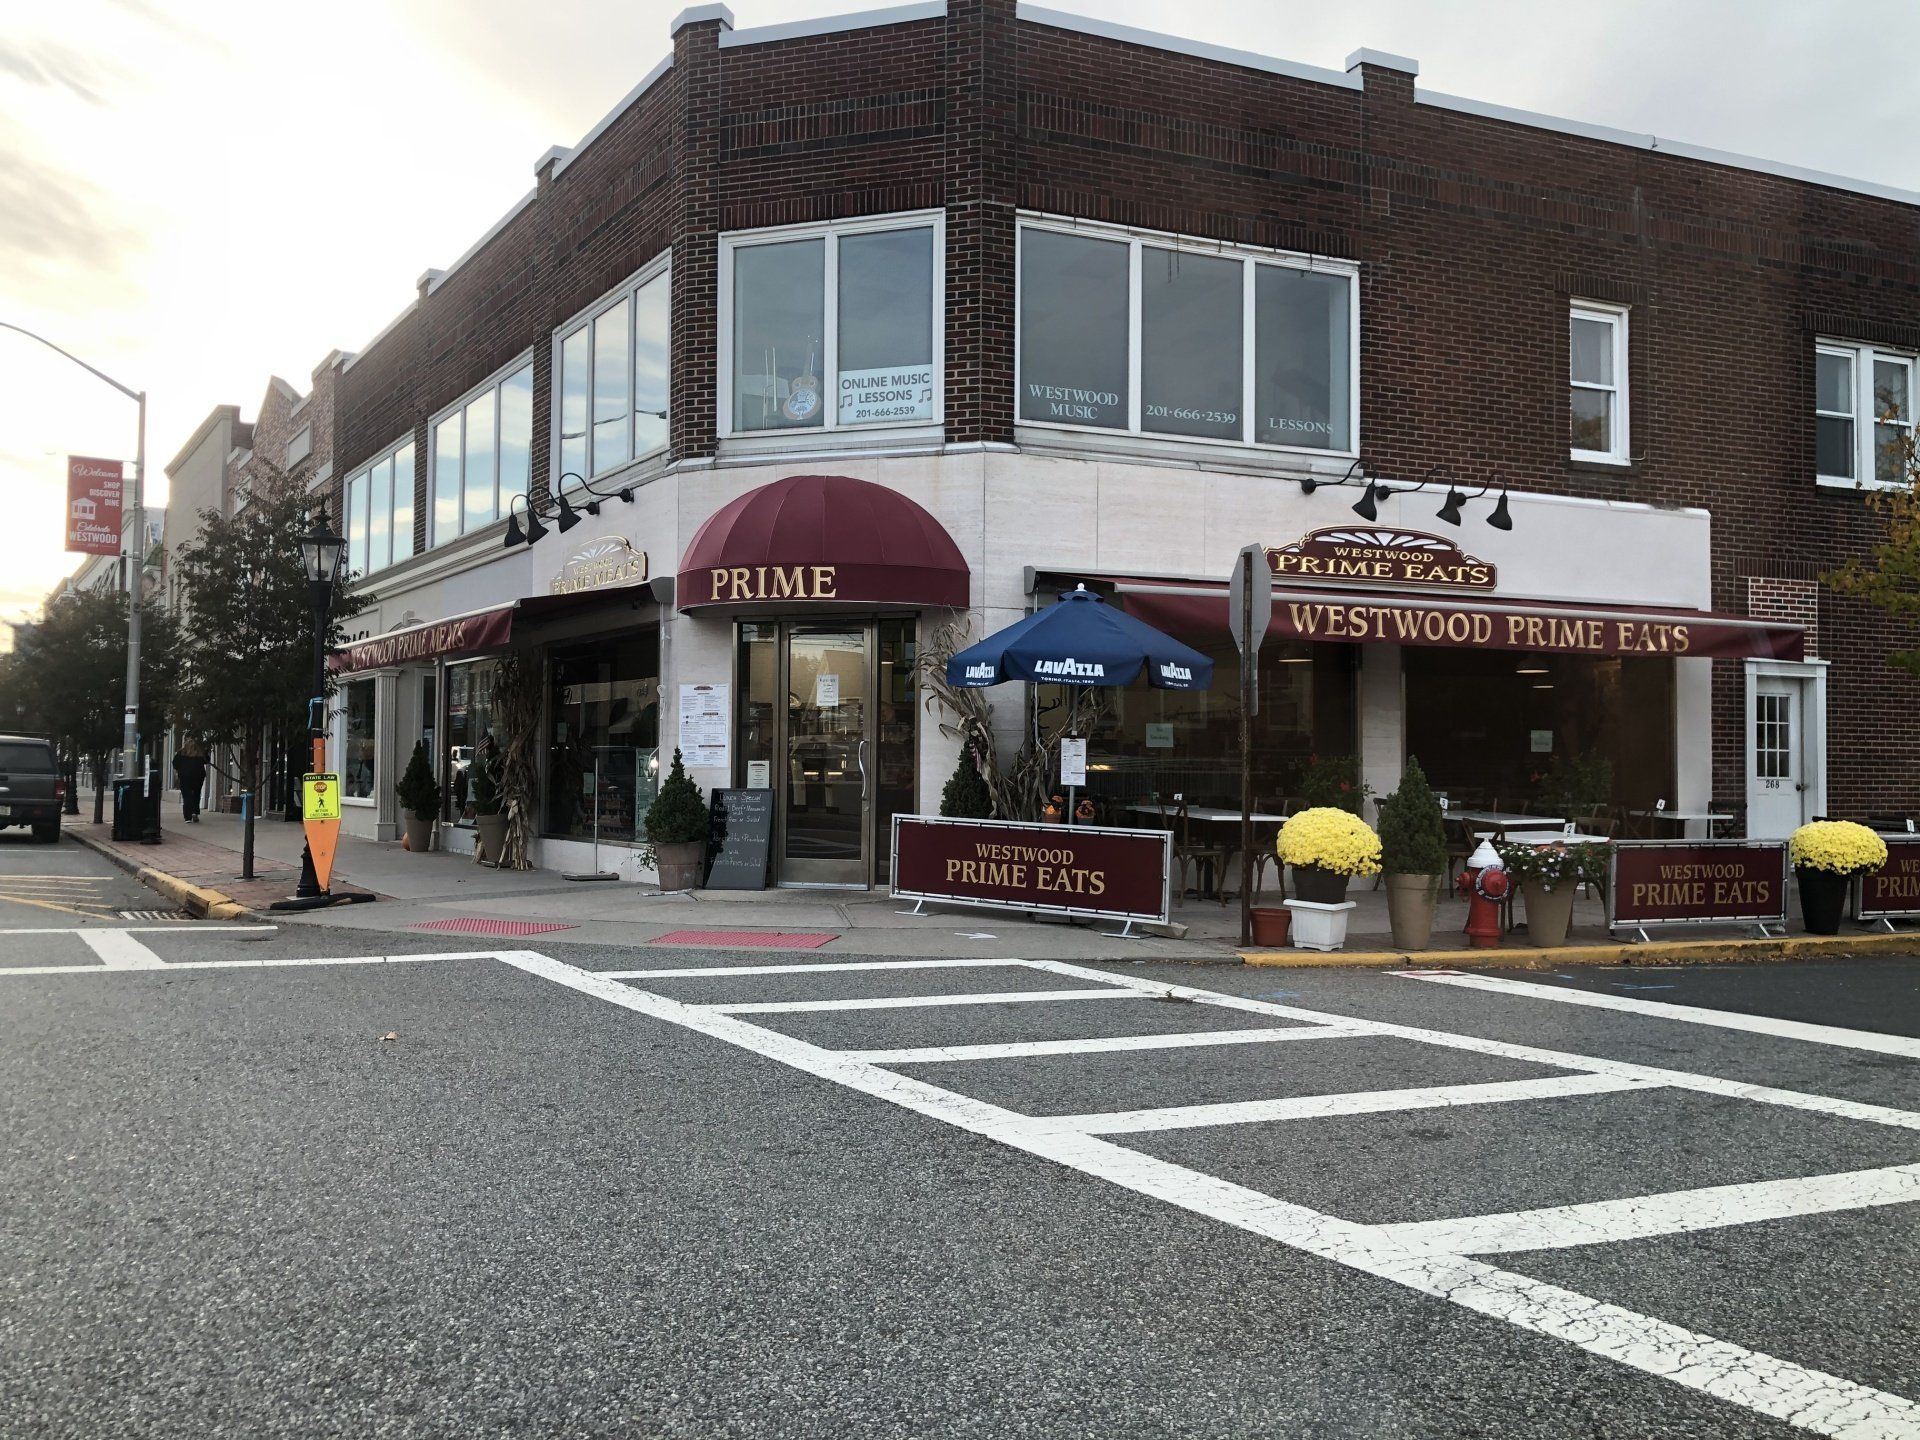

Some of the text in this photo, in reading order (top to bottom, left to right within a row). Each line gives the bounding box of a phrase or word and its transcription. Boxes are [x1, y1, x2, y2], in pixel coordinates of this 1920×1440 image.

[841, 373, 930, 390] ONLINE MUSIC
[858, 389, 912, 404] LESSONS
[1029, 384, 1119, 406] WESTWOOD
[856, 406, 915, 418] 201-666-2539
[1050, 402, 1098, 420] MUSIC
[1269, 417, 1334, 435] LESSONS
[89, 489, 120, 498] DISCOVER
[104, 481, 120, 489] SHOP
[104, 498, 120, 507] DINE
[70, 531, 117, 544] WESTWOOD
[1333, 546, 1434, 562] WESTWOOD
[573, 557, 614, 575] WESTWOOD
[1274, 553, 1489, 584] PRIME EATS
[552, 560, 639, 595] PRIME MEATS
[710, 566, 837, 601] PRIME
[1288, 603, 1690, 653] WESTWOOD PRIME EATS
[399, 630, 427, 660] PRIME
[429, 621, 466, 653] MEATS
[1765, 780, 1780, 789] 268
[1566, 825, 1572, 834] 2
[975, 843, 1074, 865] WESTWOOD
[946, 858, 1105, 895] PRIME EATS
[1660, 864, 1745, 880] WESTWOOD
[1632, 880, 1770, 906] PRIME EATS
